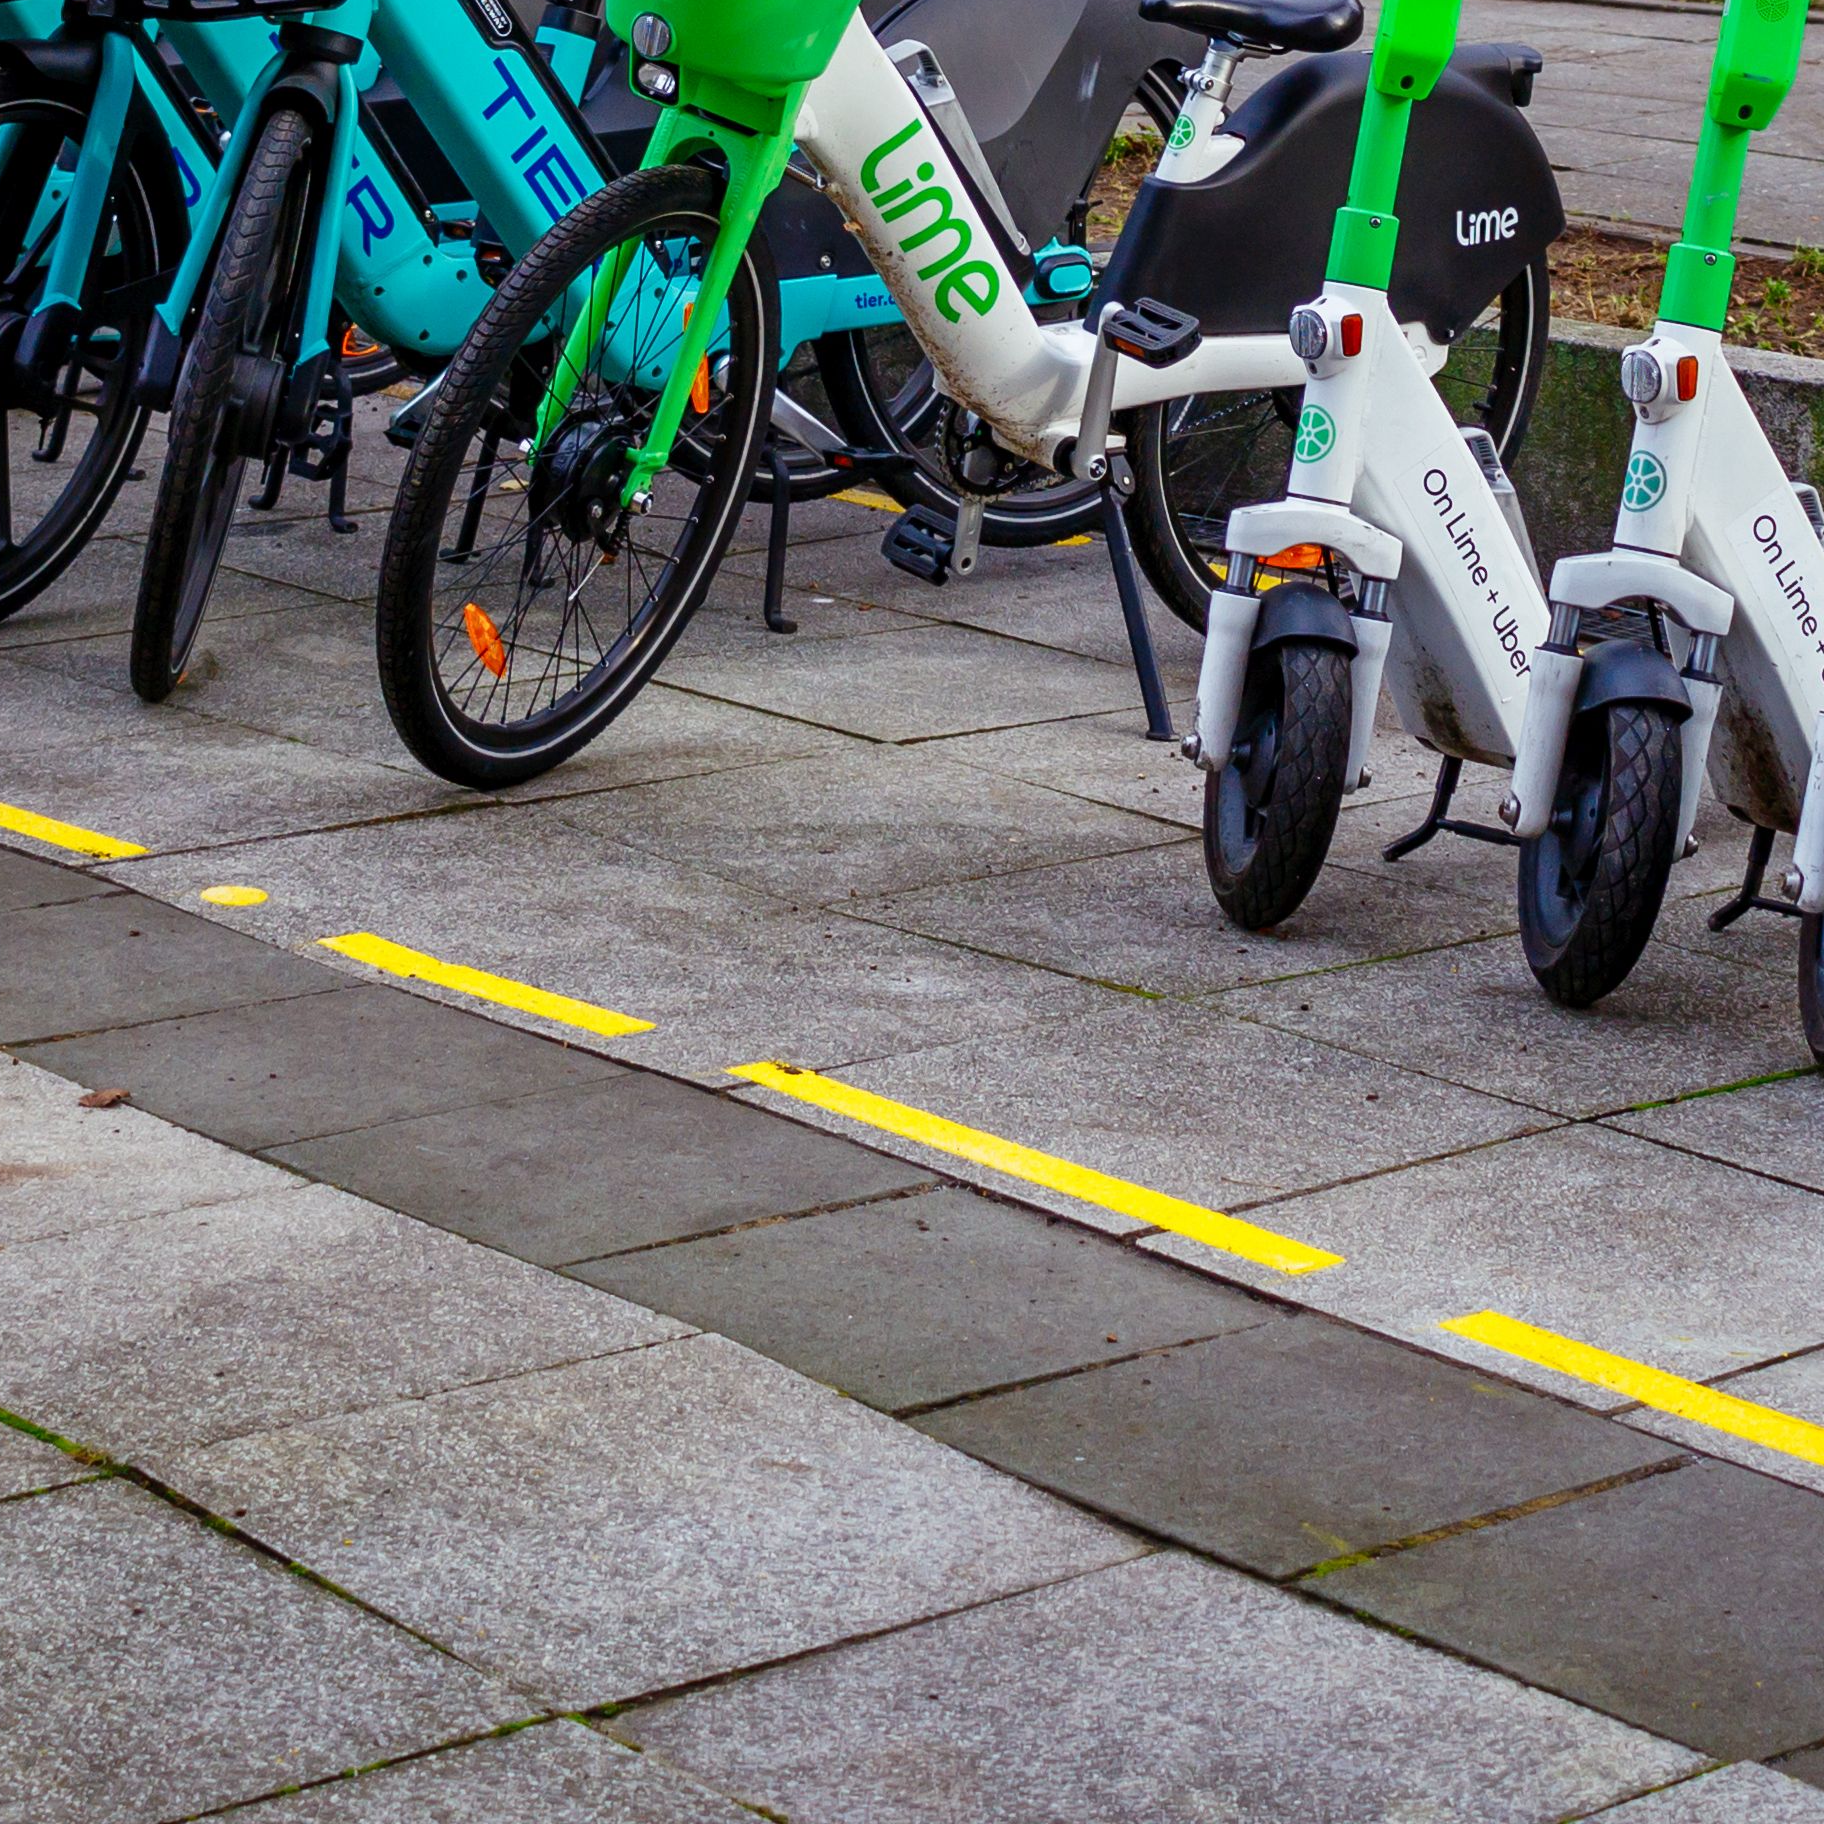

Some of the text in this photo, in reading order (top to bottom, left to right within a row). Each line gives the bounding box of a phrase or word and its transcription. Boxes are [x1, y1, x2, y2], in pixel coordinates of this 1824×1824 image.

[482, 57, 588, 224] TIE
[860, 118, 1000, 324] Lime
[1423, 469, 1532, 677] On Lime + Uber
[1753, 515, 1782, 564] On
[1775, 560, 1818, 637] Lime
